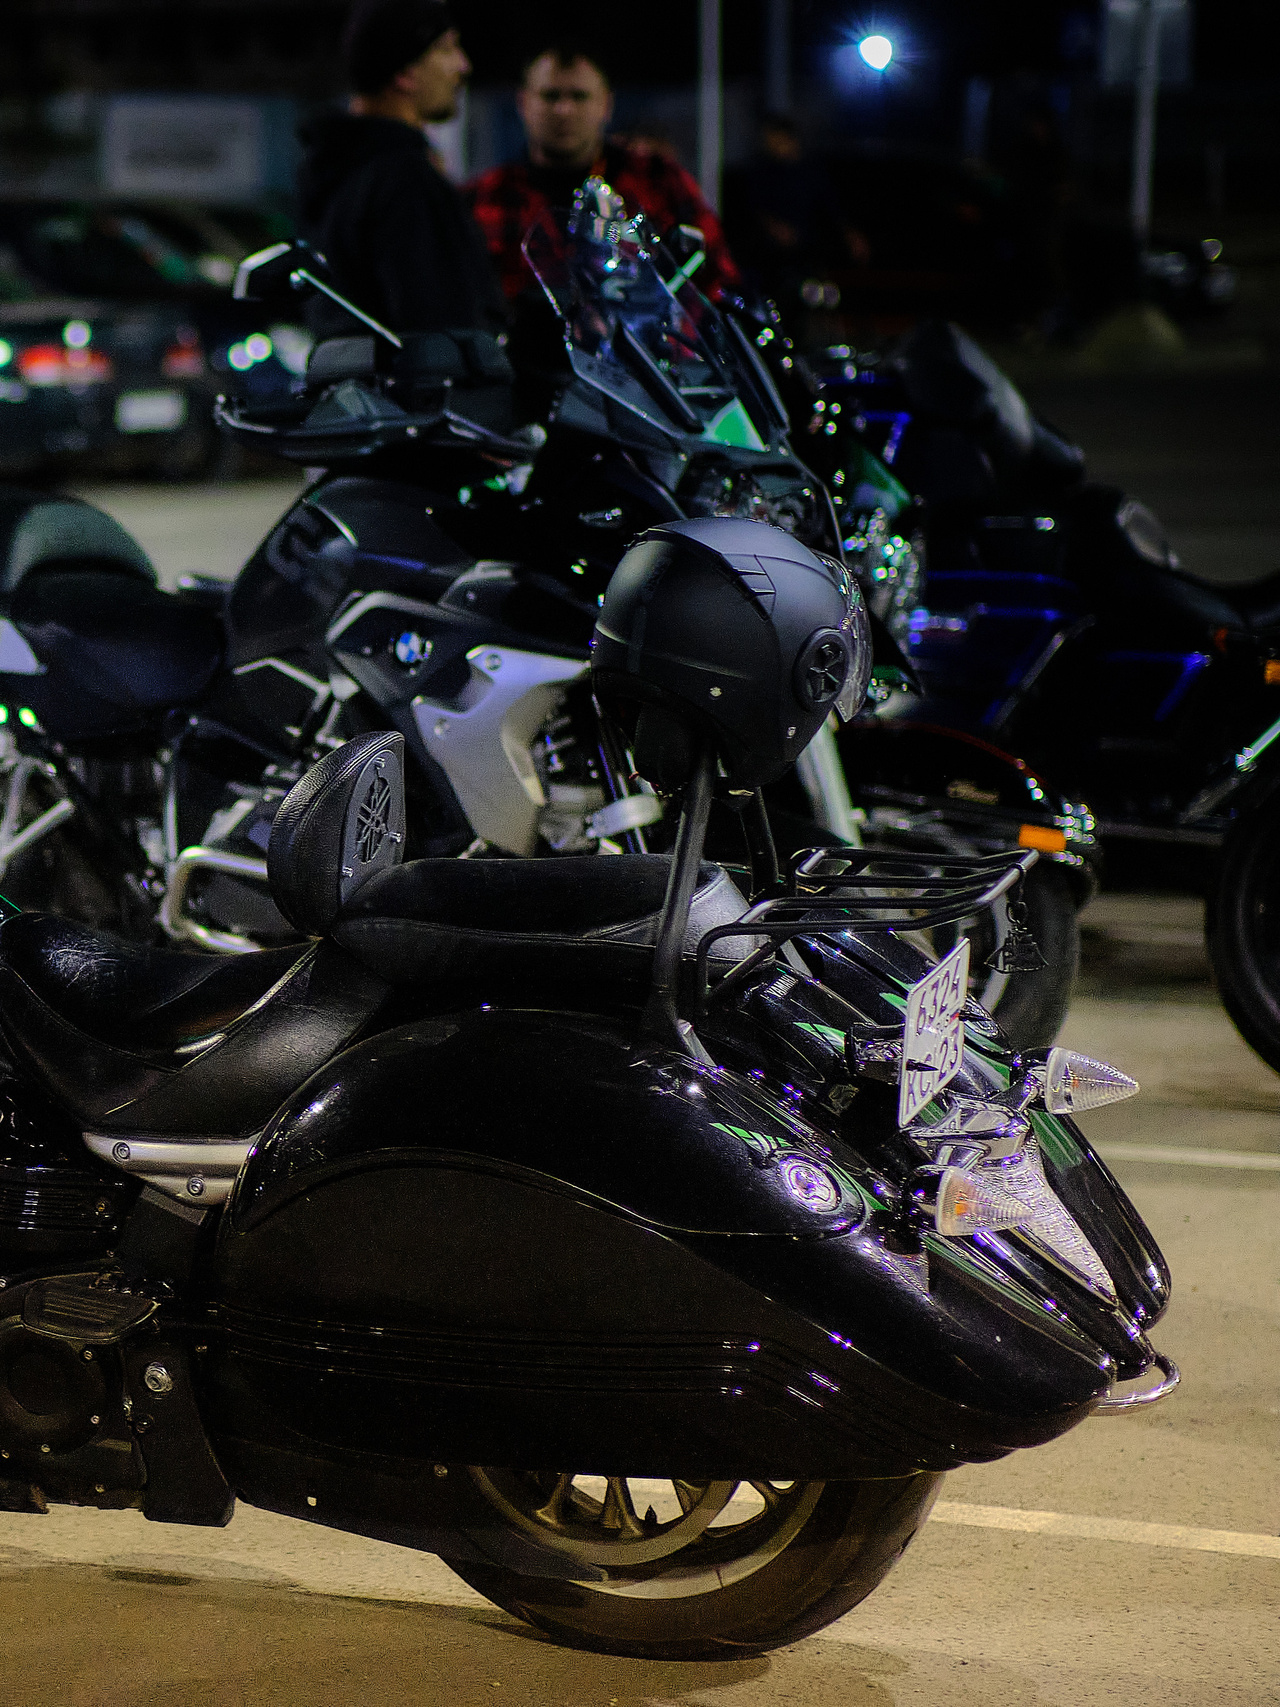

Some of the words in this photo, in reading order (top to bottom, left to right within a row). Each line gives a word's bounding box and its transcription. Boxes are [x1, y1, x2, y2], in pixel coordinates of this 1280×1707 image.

[763, 973, 799, 998] YAMAHA
[916, 955, 961, 1037] 6324
[938, 1022, 960, 1083] 23
